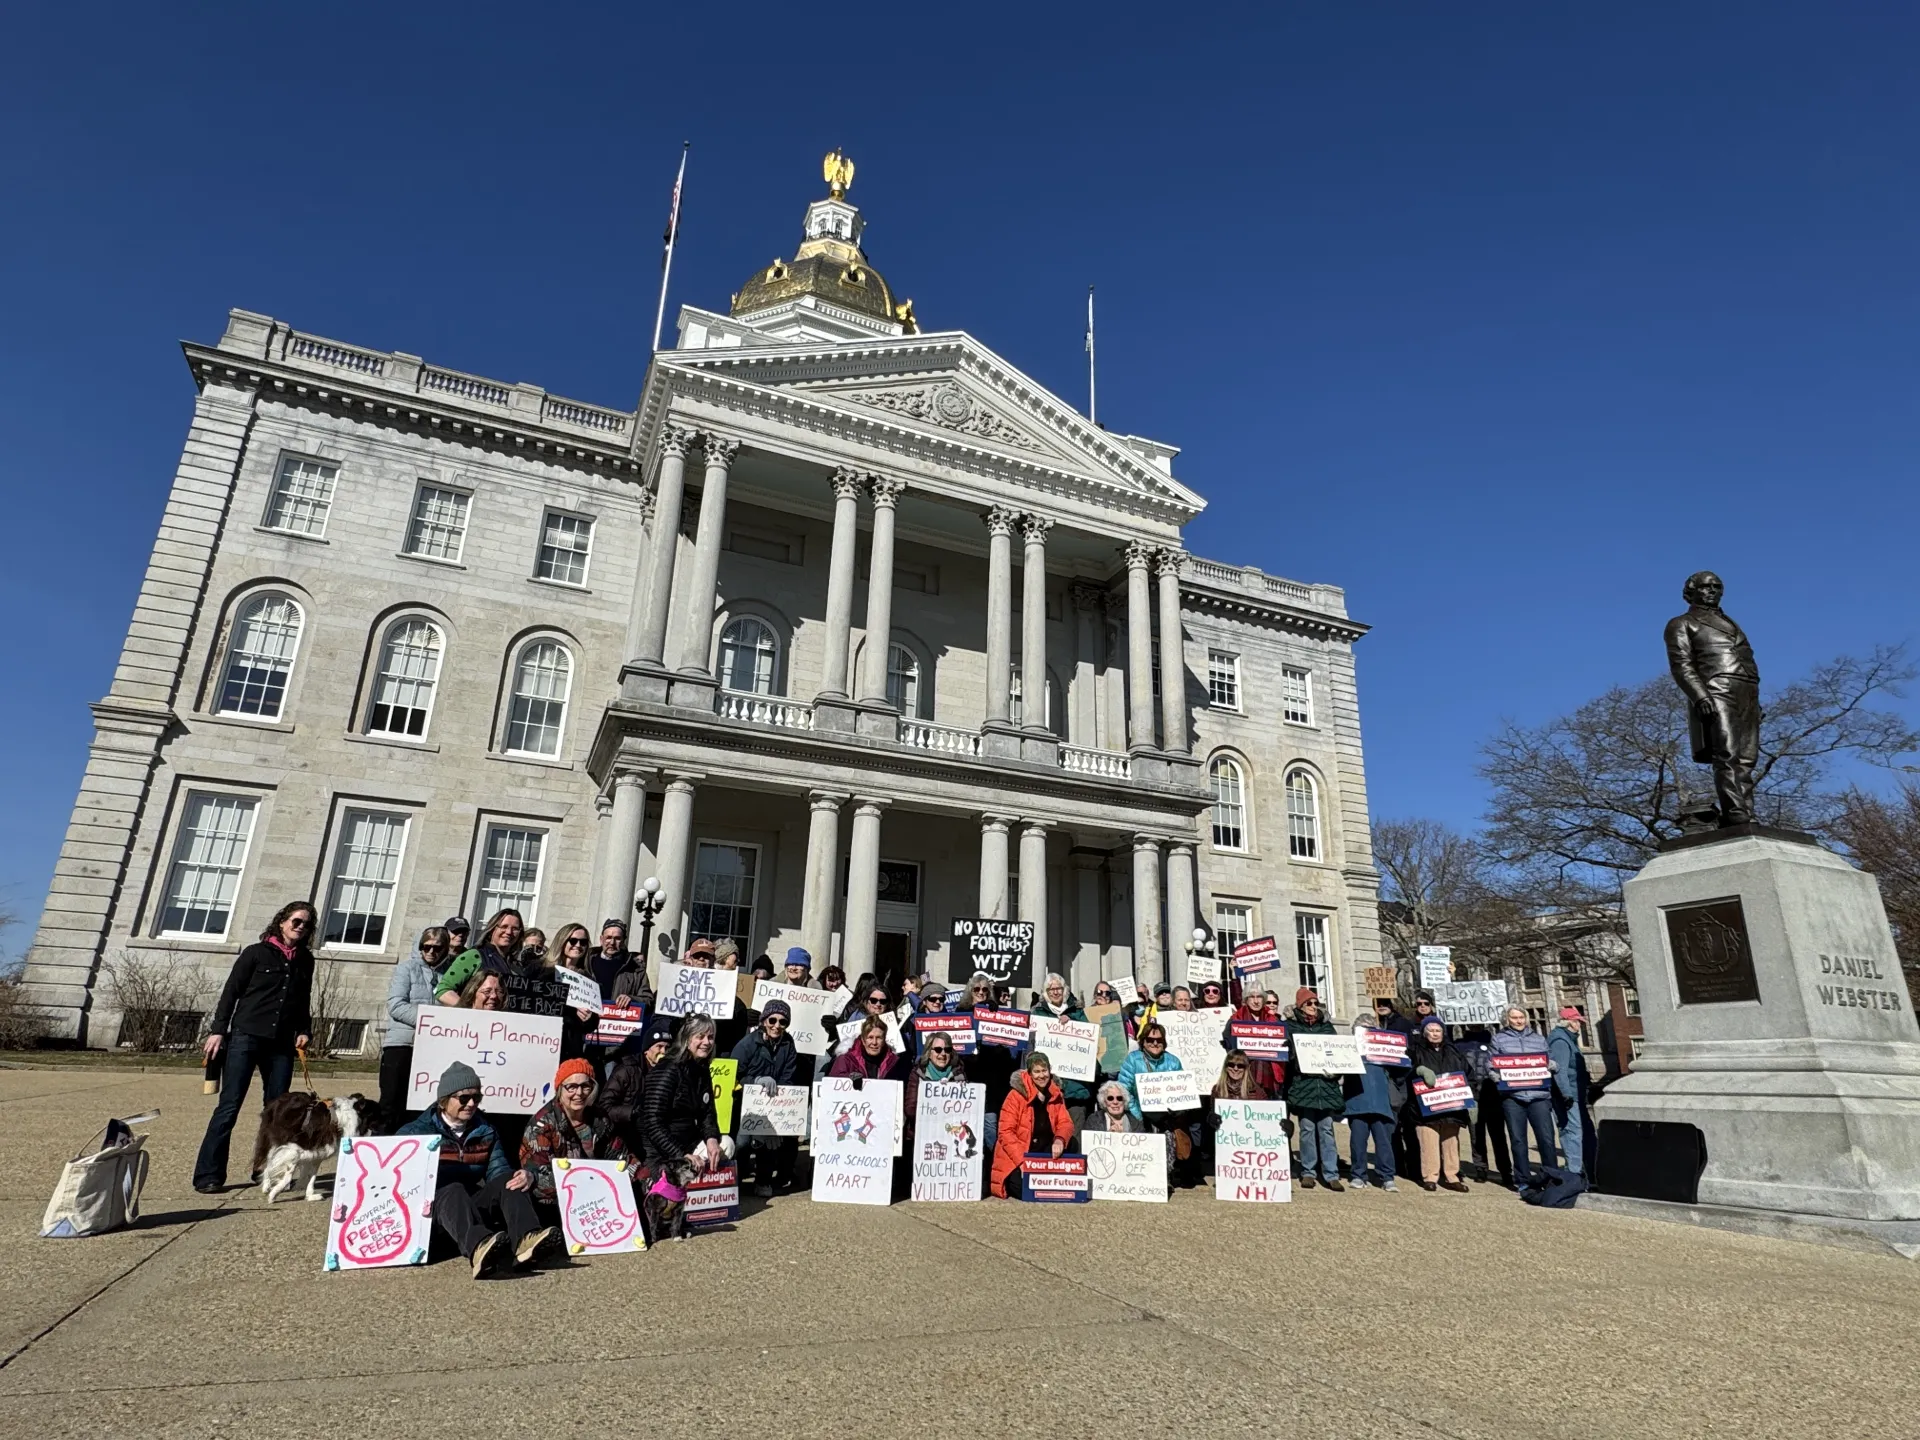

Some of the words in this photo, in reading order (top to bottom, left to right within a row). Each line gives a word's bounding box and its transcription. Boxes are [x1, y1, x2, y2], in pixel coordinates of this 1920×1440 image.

[954, 920, 973, 936] NO
[976, 921, 1034, 940] VACCINES
[970, 936, 996, 952] FOR
[1369, 968, 1391, 976] GOP
[1819, 954, 1884, 980] DANIEL
[679, 968, 715, 985] SAVE
[569, 984, 598, 998] AMILY
[674, 983, 716, 1002] CHILD
[758, 984, 784, 999] DEM
[788, 990, 829, 1005] BUDGET
[1446, 985, 1489, 1000] Love
[1817, 985, 1901, 1011] WEBSTER
[536, 998, 566, 1016] BUDGET
[660, 997, 728, 1017] ADVOCATE
[917, 1020, 937, 1028] Your
[938, 1019, 970, 1028] Budget.
[976, 1010, 995, 1019] Your
[996, 1012, 1026, 1024] Budget.
[1176, 1012, 1208, 1024] STOP
[418, 1015, 478, 1050] Family
[490, 1022, 560, 1054] Planning
[841, 1024, 857, 1035] CUT
[980, 1024, 999, 1033] Your
[1000, 1027, 1028, 1038] Future.
[1164, 1024, 1200, 1036] USHING
[1204, 1026, 1216, 1036] UP
[1252, 1026, 1284, 1036] Budget.
[1068, 1041, 1090, 1055] school
[1178, 1036, 1218, 1047] PROPERT
[1296, 1039, 1322, 1051] Family
[1324, 1040, 1358, 1053] Planning
[477, 1051, 506, 1065] IS
[1178, 1048, 1209, 1057] TAXES
[1058, 1062, 1087, 1075] instead
[1514, 1057, 1546, 1066] Budget.
[834, 1079, 871, 1092] DOT
[1139, 1074, 1173, 1083] Education
[925, 1083, 976, 1100] BEWARE
[1142, 1086, 1161, 1095] take
[832, 1101, 870, 1116] TEAR
[920, 1102, 938, 1115] the
[943, 1100, 972, 1114] GOP
[1218, 1105, 1240, 1120] We
[1244, 1104, 1283, 1121] Demand
[1093, 1133, 1112, 1146] NH
[1122, 1134, 1147, 1146] GOP
[1216, 1129, 1252, 1146] Better
[1254, 1131, 1287, 1149] Budget
[818, 1153, 840, 1165] OUR
[844, 1154, 888, 1168] SCHOOLS
[1122, 1151, 1153, 1162] HANDS
[1231, 1151, 1279, 1167] STOP
[915, 1161, 968, 1178] VOUCHER
[1025, 1160, 1047, 1169] Your
[1048, 1161, 1083, 1172] Budget.
[1126, 1163, 1147, 1174] OFF
[1218, 1165, 1263, 1180] PROJECT
[1266, 1169, 1289, 1181] 2025
[826, 1173, 871, 1189] APART
[914, 1182, 975, 1200] VULTURE
[1108, 1184, 1136, 1195] PUBLIC
[709, 1192, 737, 1203] Future.
[347, 1216, 395, 1246] PEEPS
[582, 1219, 624, 1243] PEEPS
[359, 1231, 403, 1257] PEEPS
